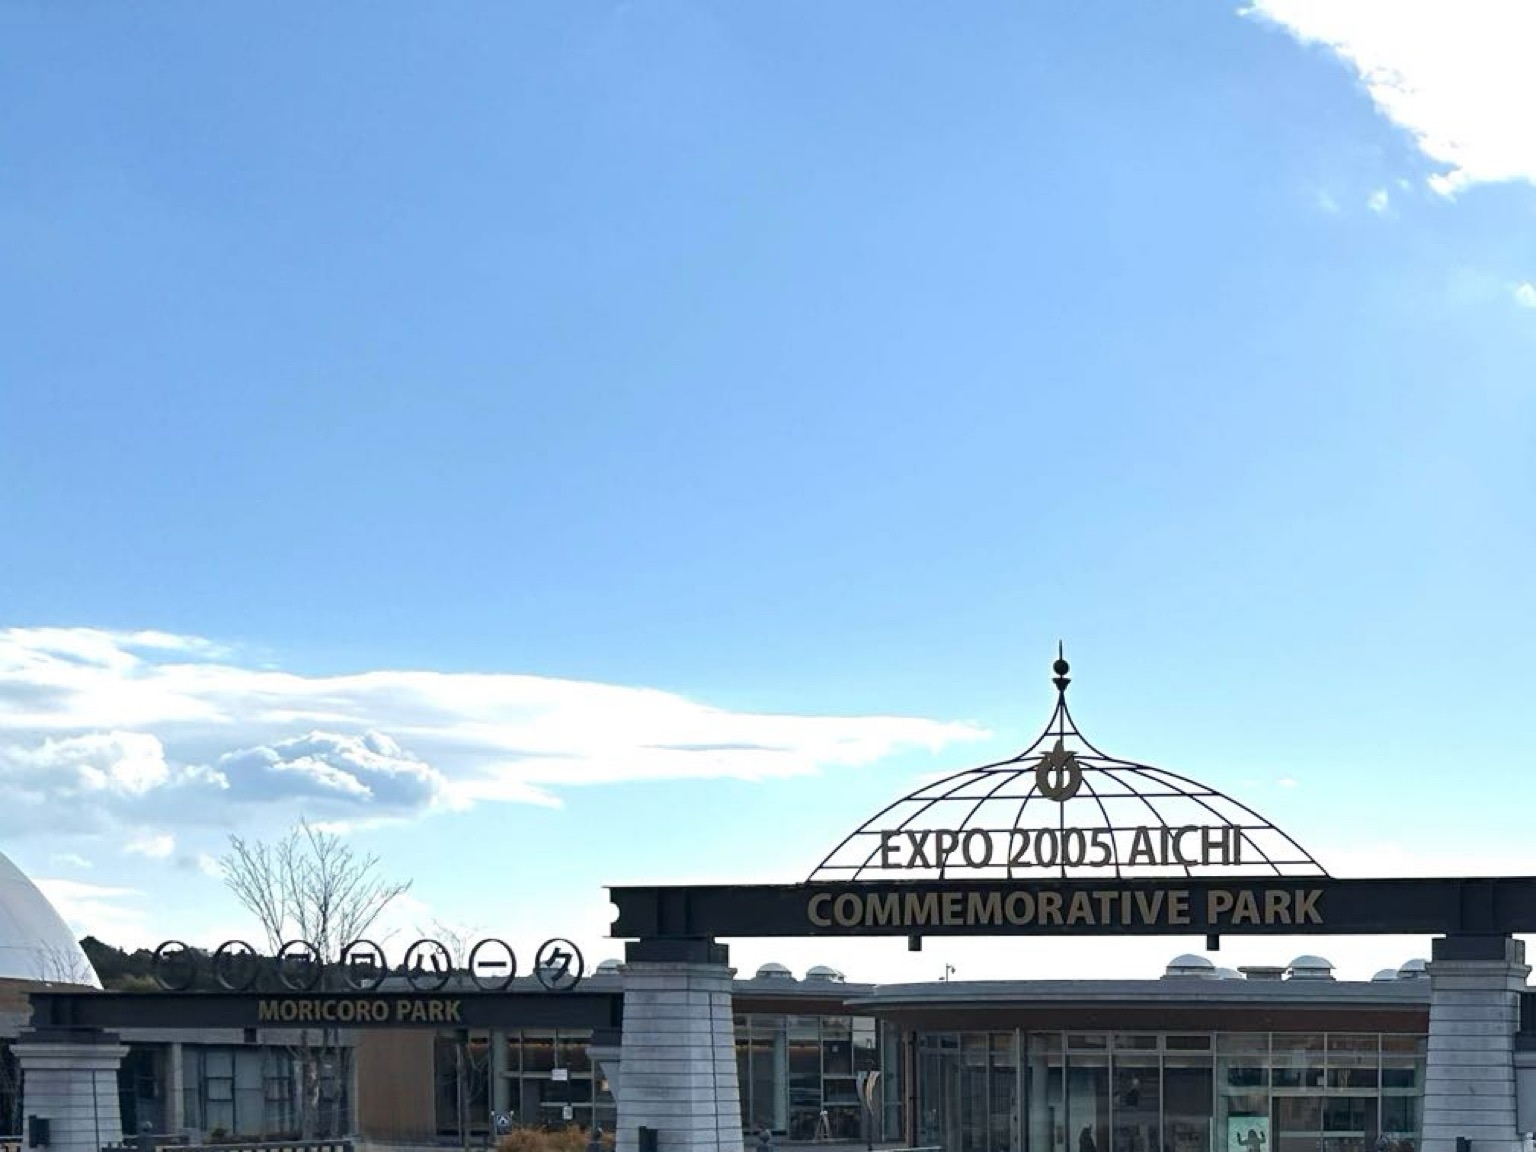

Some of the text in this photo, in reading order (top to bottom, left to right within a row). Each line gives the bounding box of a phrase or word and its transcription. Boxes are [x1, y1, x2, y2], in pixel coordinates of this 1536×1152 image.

[880, 825, 1242, 869] EXPO 2005 AICHI
[807, 888, 1324, 926] COMMEMORATIVE PARK
[258, 999, 461, 1022] MORICORO PARK
